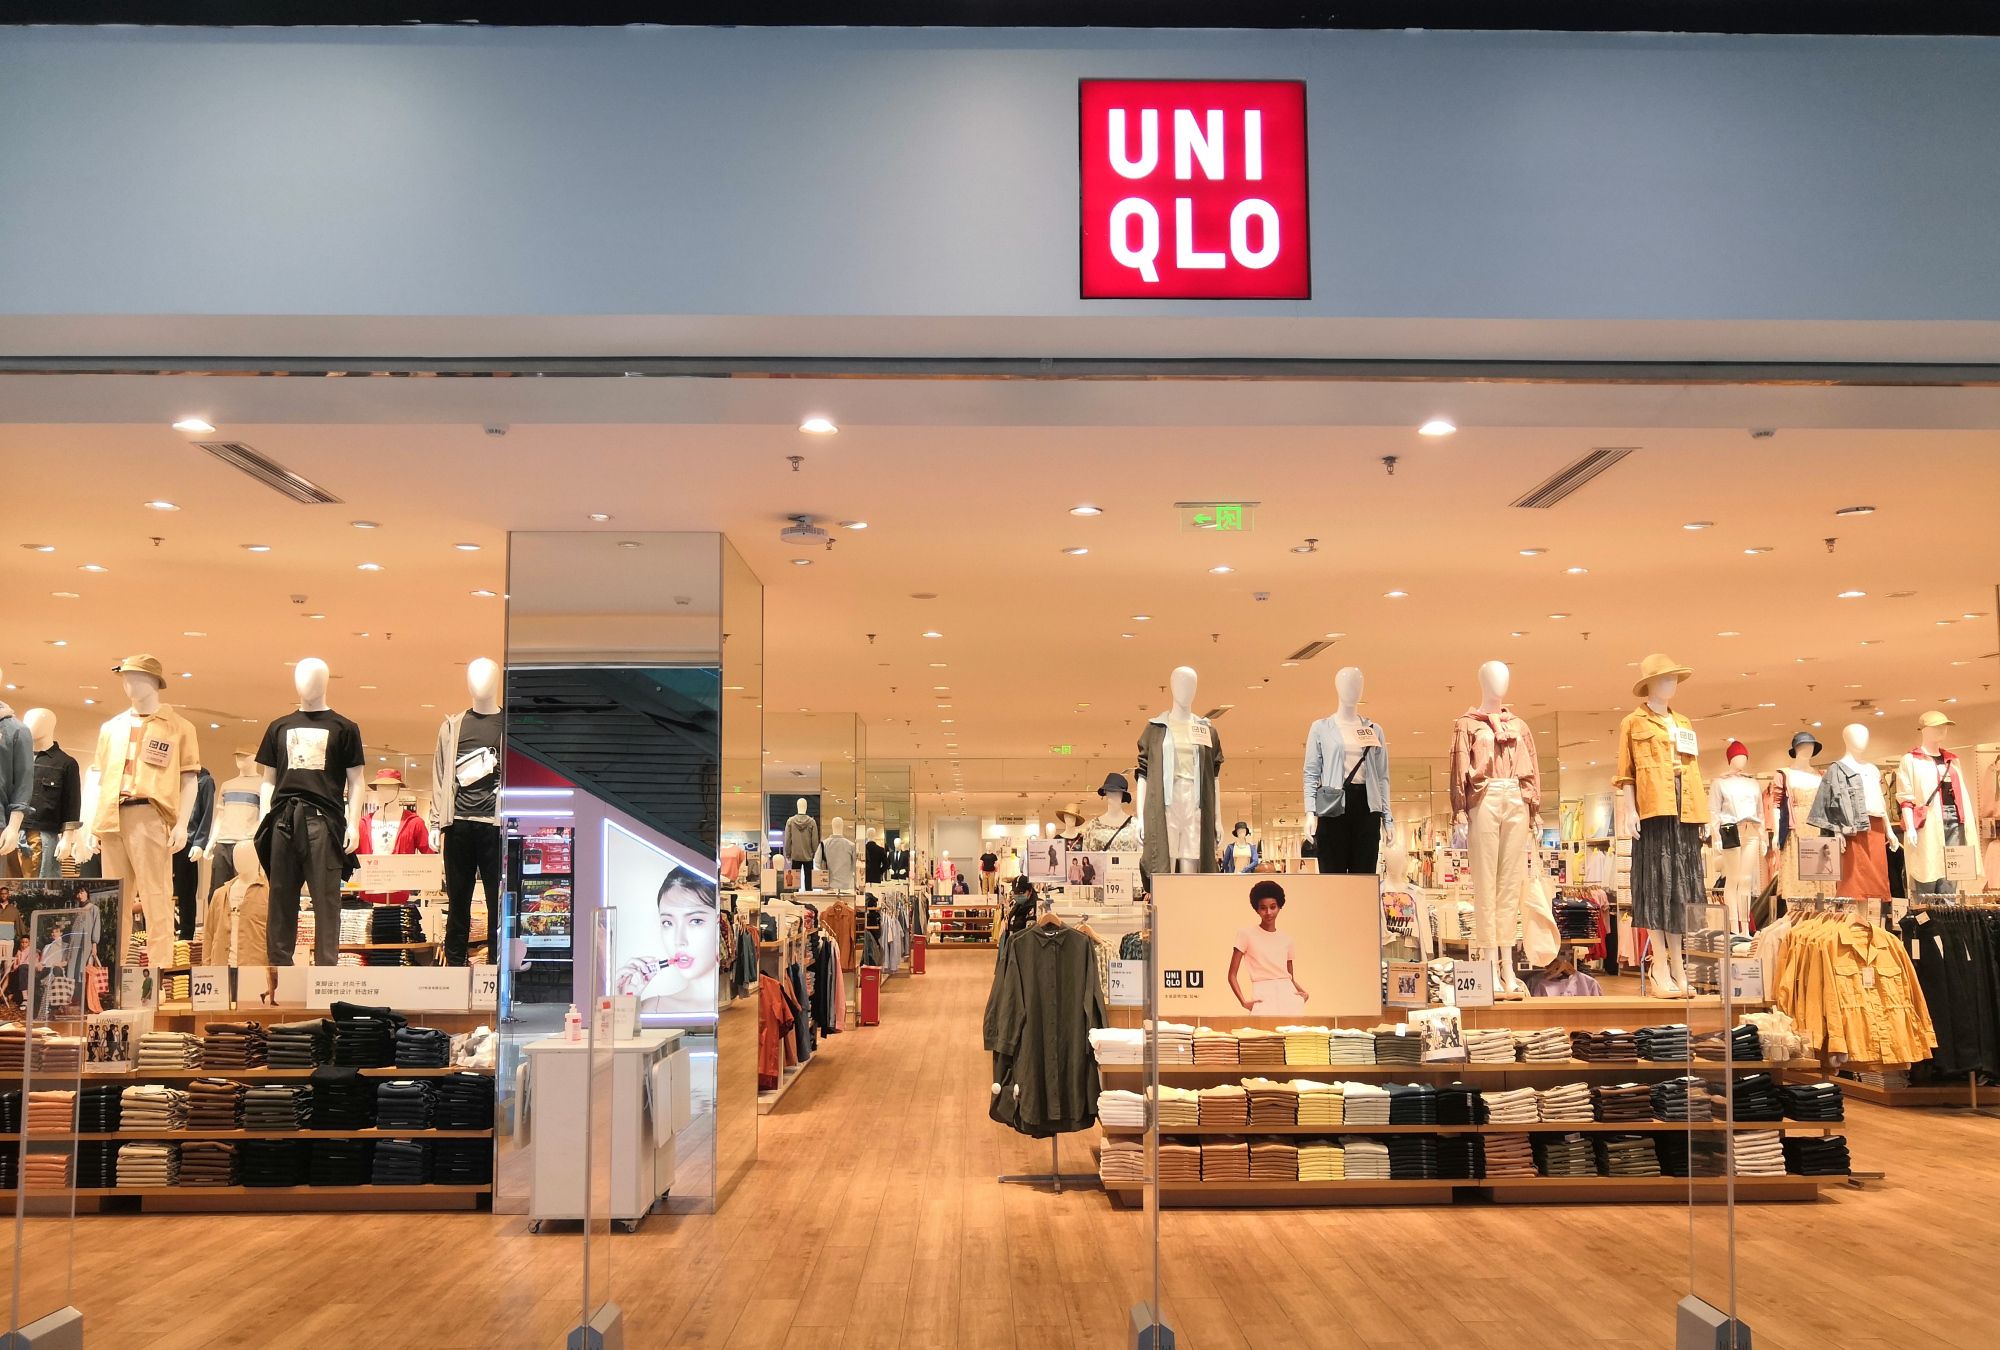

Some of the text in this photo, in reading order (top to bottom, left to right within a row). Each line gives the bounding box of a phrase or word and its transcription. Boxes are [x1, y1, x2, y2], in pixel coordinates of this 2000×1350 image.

[1108, 108, 1263, 180] UNI
[1109, 197, 1280, 283] QLO
[1947, 861, 1958, 869] 299
[1106, 884, 1120, 894] 199
[1111, 979, 1120, 989] 79
[1165, 979, 1181, 987] QLO
[1189, 972, 1200, 986] U
[1457, 978, 1475, 990] 249
[194, 982, 212, 995] 249
[483, 981, 496, 994] 79
